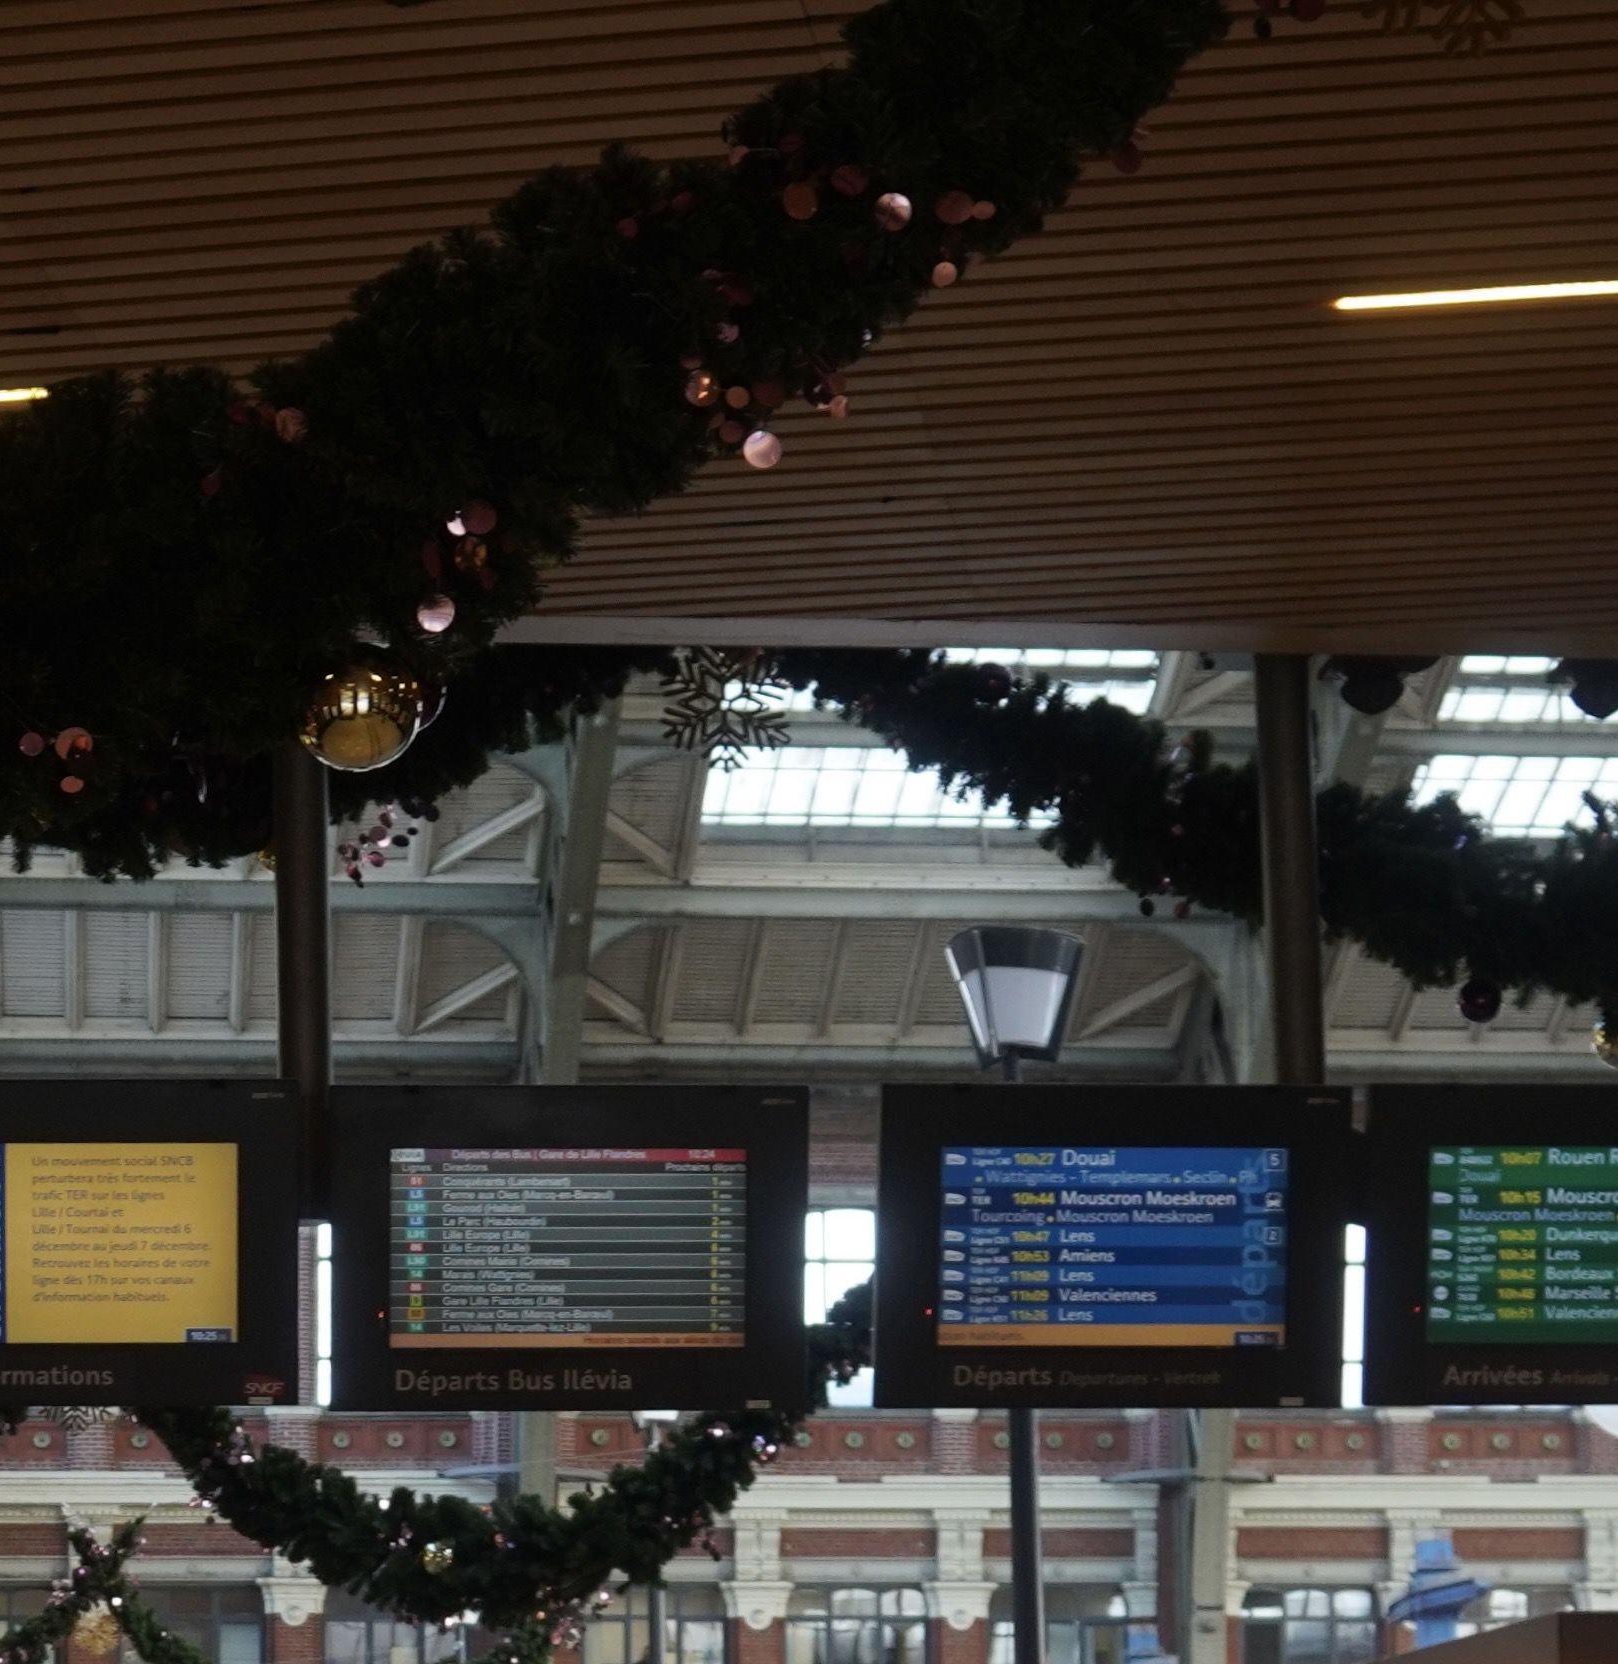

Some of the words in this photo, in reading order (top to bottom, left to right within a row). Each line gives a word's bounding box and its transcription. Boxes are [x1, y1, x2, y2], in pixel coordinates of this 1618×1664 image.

[52, 1156, 121, 1166] mouvement
[124, 1156, 157, 1166] social
[160, 1156, 193, 1166] SNCB
[1062, 1149, 1116, 1166] Douai
[1547, 1148, 1605, 1164] Rouen
[442, 1164, 488, 1172] Directions
[97, 1173, 119, 1183] très
[122, 1173, 181, 1183] fortement
[185, 1173, 195, 1183] le
[1081, 1170, 1173, 1186] Templemars
[32, 1190, 62, 1200] trafic
[66, 1190, 88, 1200] TER
[92, 1190, 109, 1200] sur
[112, 1190, 127, 1200] les
[131, 1190, 164, 1203] lignes
[1060, 1190, 1143, 1206] Mouscron
[1145, 1191, 1237, 1207] Moeskroen
[32, 1208, 56, 1216] Lille
[111, 1208, 124, 1216] et
[972, 1209, 1045, 1226] Tourcoing
[1056, 1210, 1130, 1223] Mouscron
[1132, 1210, 1214, 1224] Moeskroen
[1459, 1209, 1531, 1221] Mouscron
[1535, 1209, 1614, 1222] Moeskroen
[32, 1224, 56, 1234] Lille
[112, 1224, 126, 1234] du
[130, 1224, 181, 1234] mercredi
[1059, 1230, 1096, 1243] Lens
[32, 1241, 88, 1251] décembre
[93, 1241, 106, 1251] au
[108, 1241, 137, 1253] jeudi
[1059, 1249, 1115, 1262] Amiens
[1546, 1248, 1581, 1260] Lens
[32, 1259, 90, 1268] Retrouvez
[94, 1259, 109, 1268] les
[113, 1259, 158, 1268] horaires
[162, 1259, 176, 1268] de
[179, 1259, 209, 1268] votre
[110, 1275, 127, 1284] sur
[154, 1275, 193, 1284] canaux
[1059, 1269, 1095, 1282] Lens
[1546, 1267, 1614, 1280] Bordeaux
[1060, 1289, 1157, 1302] Valenciennes
[1546, 1286, 1611, 1300] Marseille
[1058, 1308, 1094, 1321] Lens
[395, 1368, 500, 1395] Départs
[508, 1369, 555, 1391] Bus
[563, 1369, 632, 1391] Ilévia
[953, 1365, 1053, 1390] Départs
[1443, 1365, 1543, 1386] Arrivées
